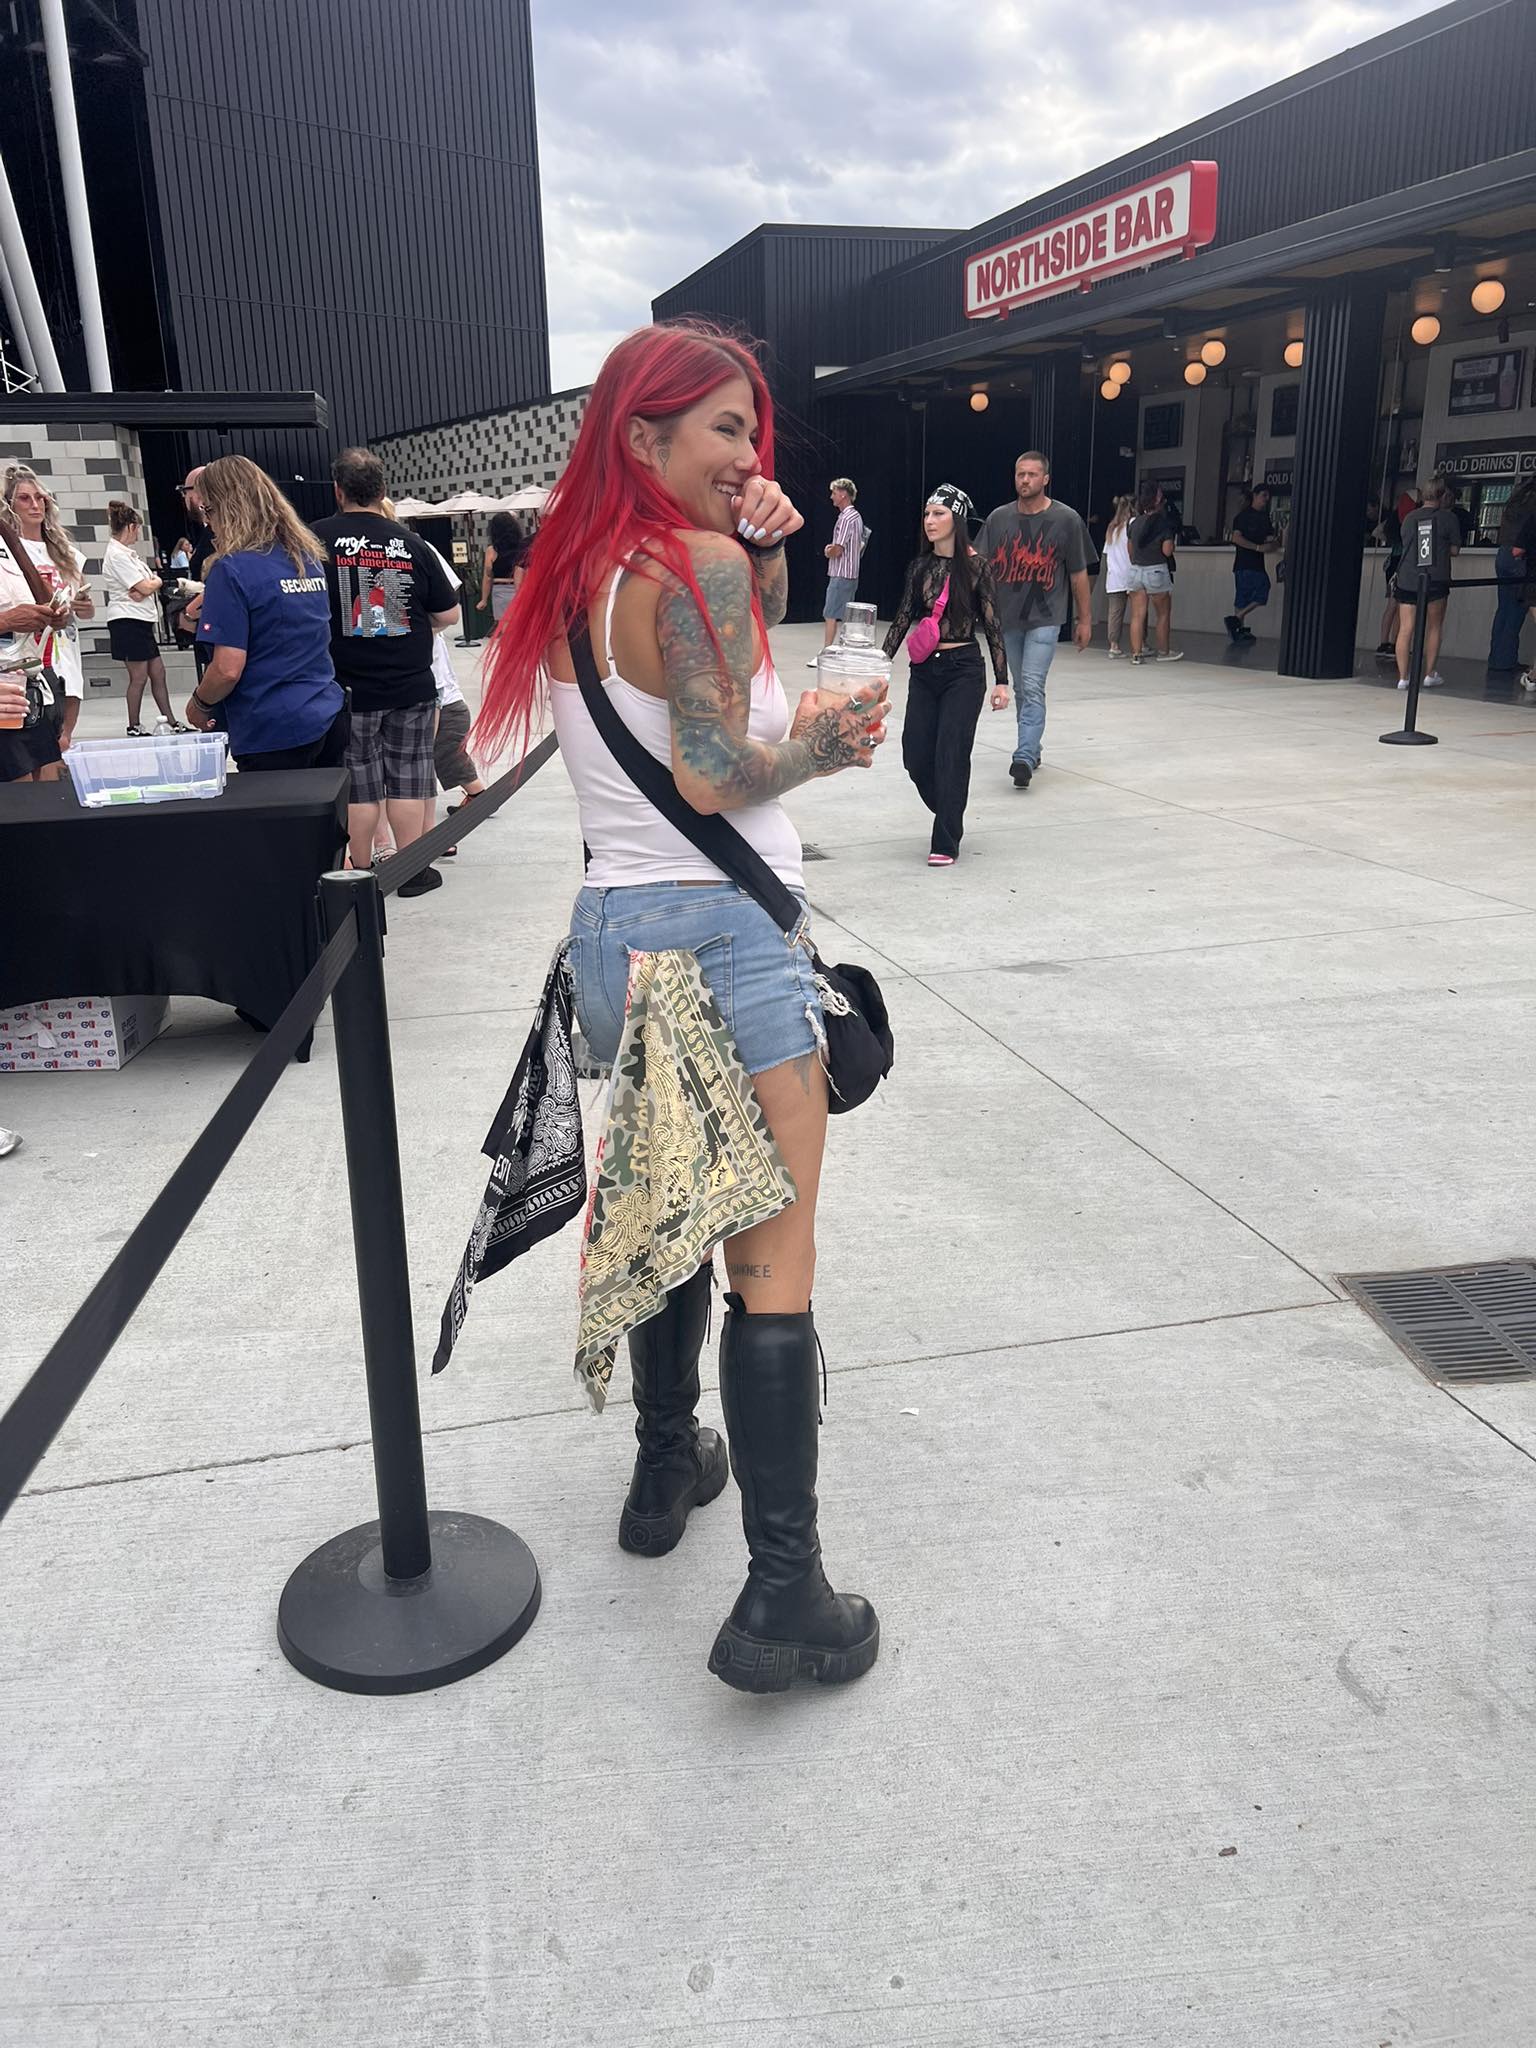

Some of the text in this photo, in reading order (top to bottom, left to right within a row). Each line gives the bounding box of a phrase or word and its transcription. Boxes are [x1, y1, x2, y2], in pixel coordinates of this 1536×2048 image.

[976, 187, 1175, 303] NORTHSIDE BAR
[1438, 456, 1514, 475] COLD DRINKS
[1266, 472, 1289, 485] COLD
[334, 535, 370, 556] mgk
[360, 548, 385, 559] tour
[336, 554, 413, 570] lost americana
[280, 577, 327, 593] SECURITY
